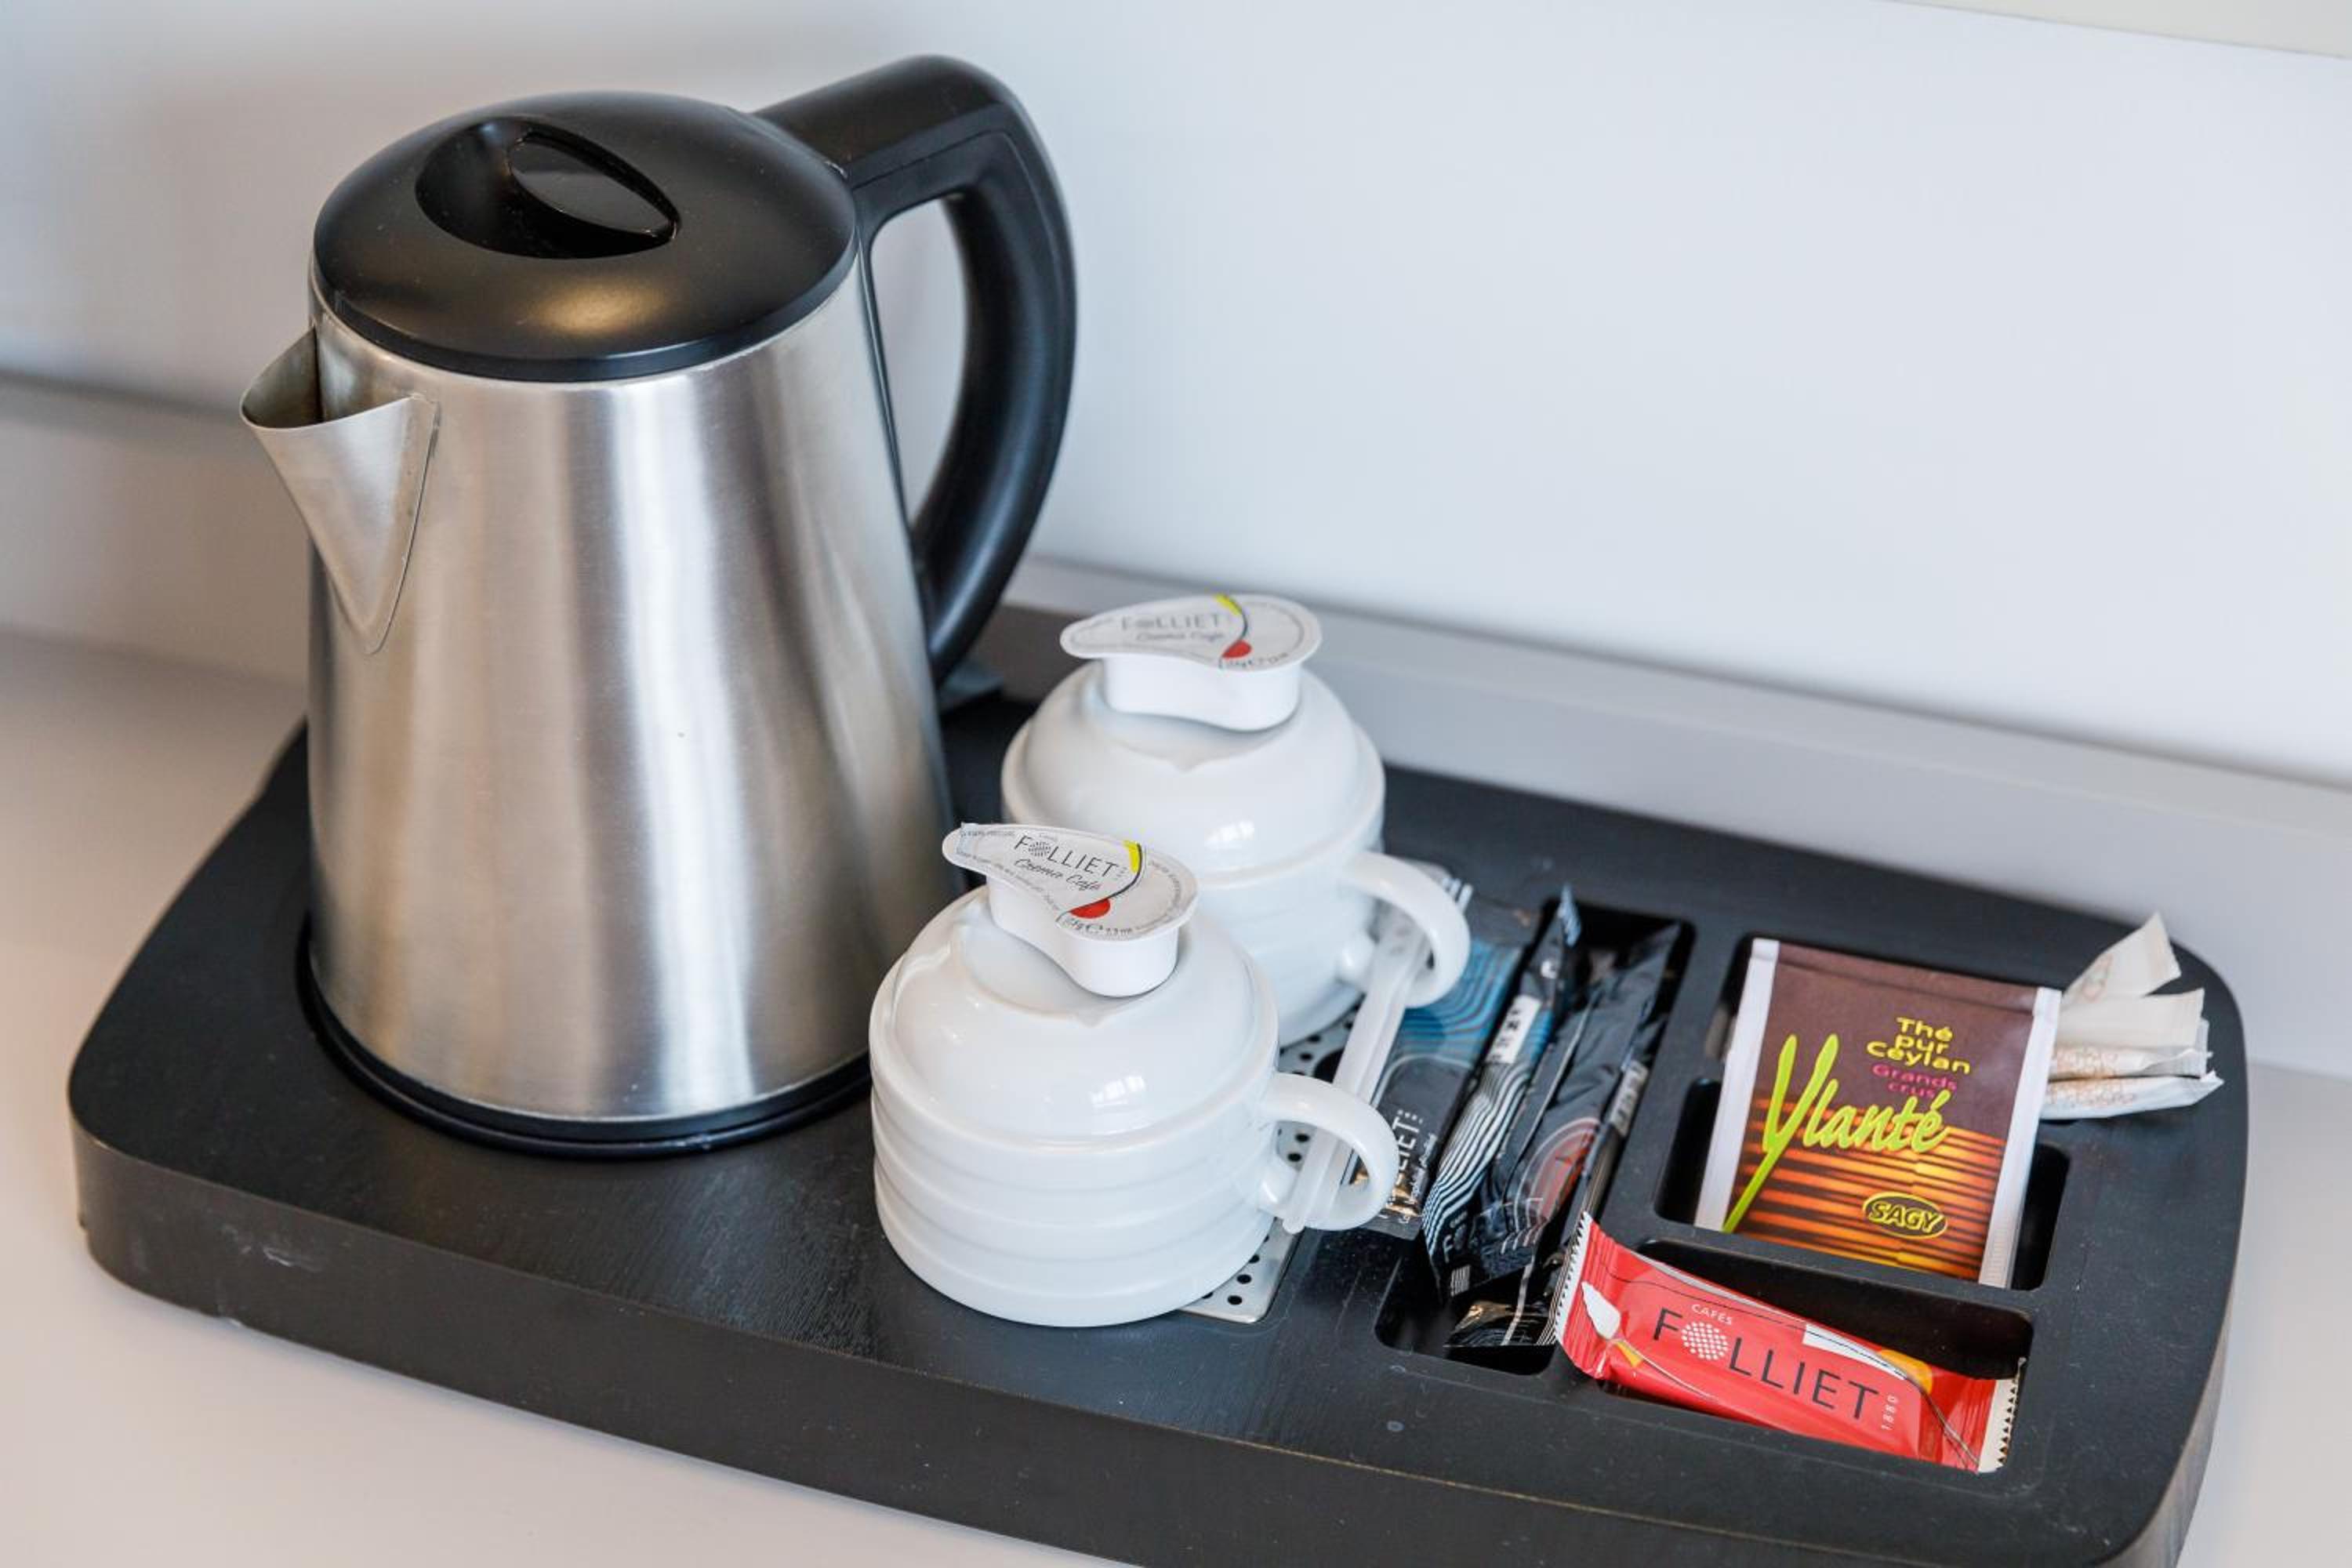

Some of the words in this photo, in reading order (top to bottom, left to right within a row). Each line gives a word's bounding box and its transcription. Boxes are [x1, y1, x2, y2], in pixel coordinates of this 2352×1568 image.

[1014, 834, 1119, 878] FOLLIET
[1865, 1040, 1971, 1075] Ceylan
[1872, 1063, 1958, 1091] Grands
[1887, 1082, 1936, 1098] crus
[1869, 1200, 1944, 1234] SAGY
[1653, 1307, 1880, 1421] FOLLIET
[1881, 1395, 1899, 1430] 1880
